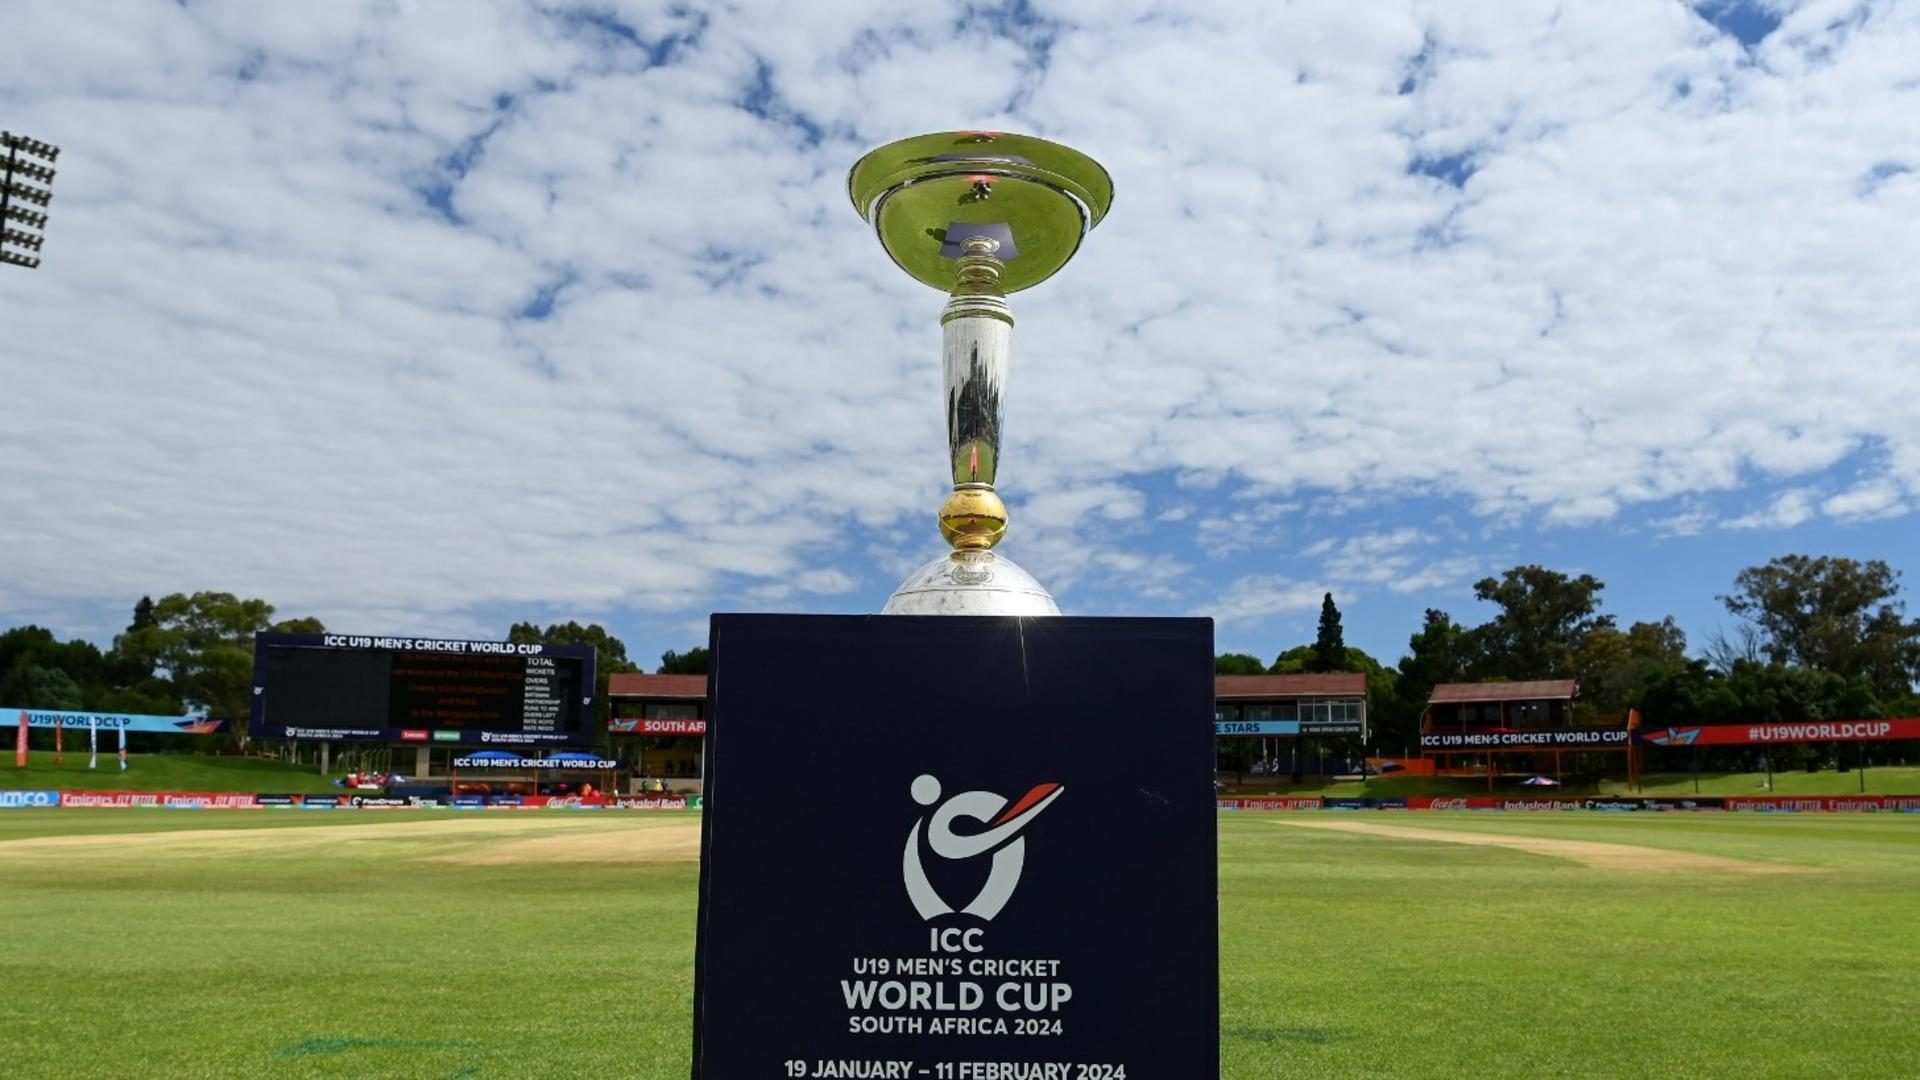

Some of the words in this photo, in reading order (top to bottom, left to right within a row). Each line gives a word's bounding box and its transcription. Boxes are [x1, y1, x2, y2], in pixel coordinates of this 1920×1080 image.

[324, 636, 347, 646] ICC
[349, 637, 371, 647] U19
[374, 638, 412, 650] MEN'S
[415, 640, 467, 652] CRICKET
[470, 642, 515, 654] WORLD
[518, 644, 543, 655] CUP
[527, 658, 555, 667] TOTAL
[526, 668, 556, 676] WICKETS
[644, 721, 685, 732] SOUTH
[1224, 722, 1260, 733] STARS
[1748, 723, 1890, 741] #U19WORLDCUP
[1420, 736, 1440, 746] ICC
[1442, 735, 1461, 745] U19
[1464, 734, 1499, 745] MEN'S
[1501, 733, 1552, 744] CRICKET
[1554, 732, 1600, 743] WORLD
[1602, 731, 1628, 742] CUP
[454, 758, 470, 767] ICC
[472, 758, 489, 767] U19
[490, 758, 519, 768] MEN'S
[520, 759, 560, 768] CRICKET
[562, 759, 596, 769] WORLD
[598, 760, 616, 769] CUP
[0, 792, 49, 805] mco
[62, 793, 114, 805] Emirates
[164, 795, 212, 805] Emirates
[661, 798, 686, 808] Bank
[1243, 799, 1284, 809] Emirates
[1552, 800, 1579, 810] Bank
[1729, 800, 1777, 812] Emirates
[1828, 799, 1878, 811] Emirates
[930, 927, 985, 953] ICC
[853, 957, 890, 976] U19
[896, 958, 963, 977] MEN'S
[968, 959, 1061, 978] CRICKET
[840, 979, 984, 1011] WORLD
[995, 982, 1073, 1012] CUP
[849, 1015, 923, 1034] SOUTH
[928, 1017, 1009, 1036] AFRICA
[1013, 1018, 1064, 1036] 2024
[784, 1059, 807, 1078] 19
[811, 1060, 914, 1080] JANUARY
[935, 1062, 953, 1080] 11
[959, 1062, 1072, 1080] FEBRUARY
[1076, 1063, 1127, 1080] 2024
